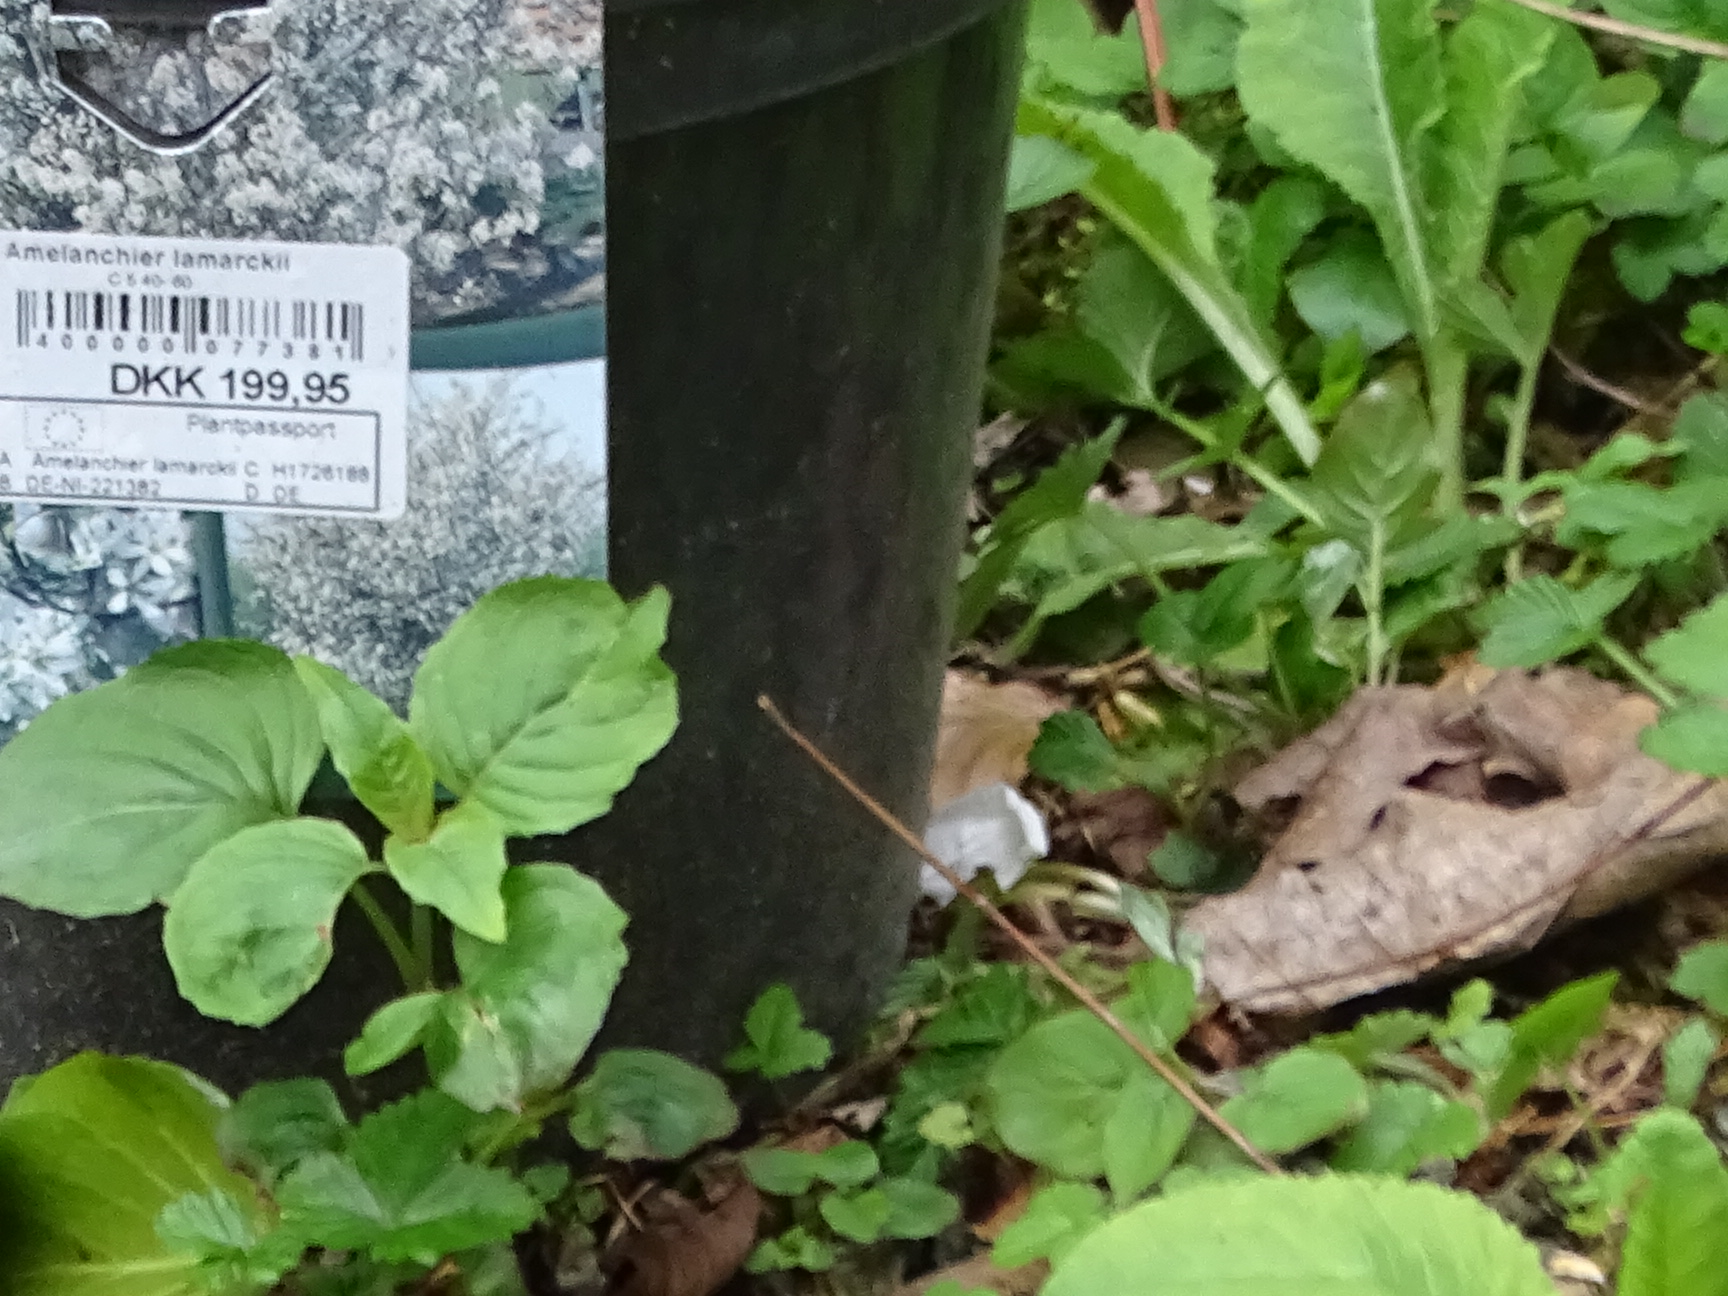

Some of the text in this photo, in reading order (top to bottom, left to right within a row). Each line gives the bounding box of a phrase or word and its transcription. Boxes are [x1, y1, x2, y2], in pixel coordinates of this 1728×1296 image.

[6, 241, 291, 272] Amelanchier lamarckii
[110, 362, 351, 407] DKK 199,95
[186, 412, 337, 442] Plantpassport
[31, 451, 149, 473] Amelanchier
[244, 460, 260, 478] C
